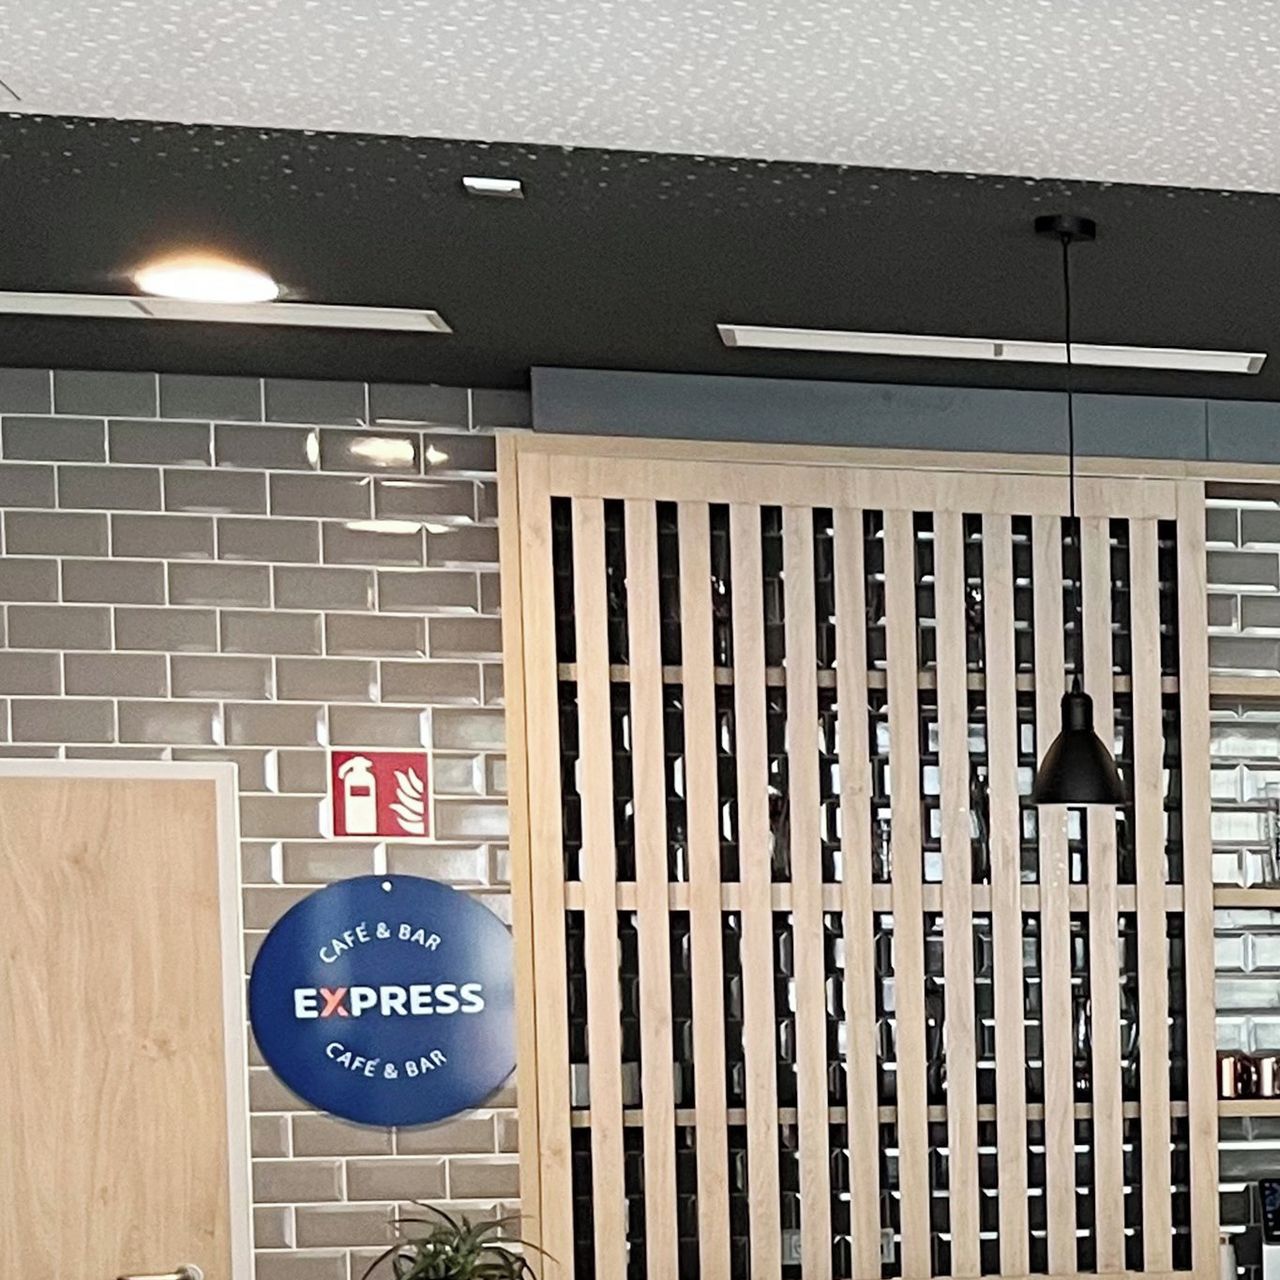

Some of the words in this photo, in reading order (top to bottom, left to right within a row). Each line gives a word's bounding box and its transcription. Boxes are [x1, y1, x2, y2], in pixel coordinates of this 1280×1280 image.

[319, 922, 371, 963] CAFÉ
[376, 922, 391, 939] &
[398, 924, 441, 951] BAR
[294, 983, 485, 1018] EXPRESS
[326, 1042, 379, 1077] CAFÉ
[384, 1063, 398, 1079] &
[405, 1050, 447, 1078] BAR
